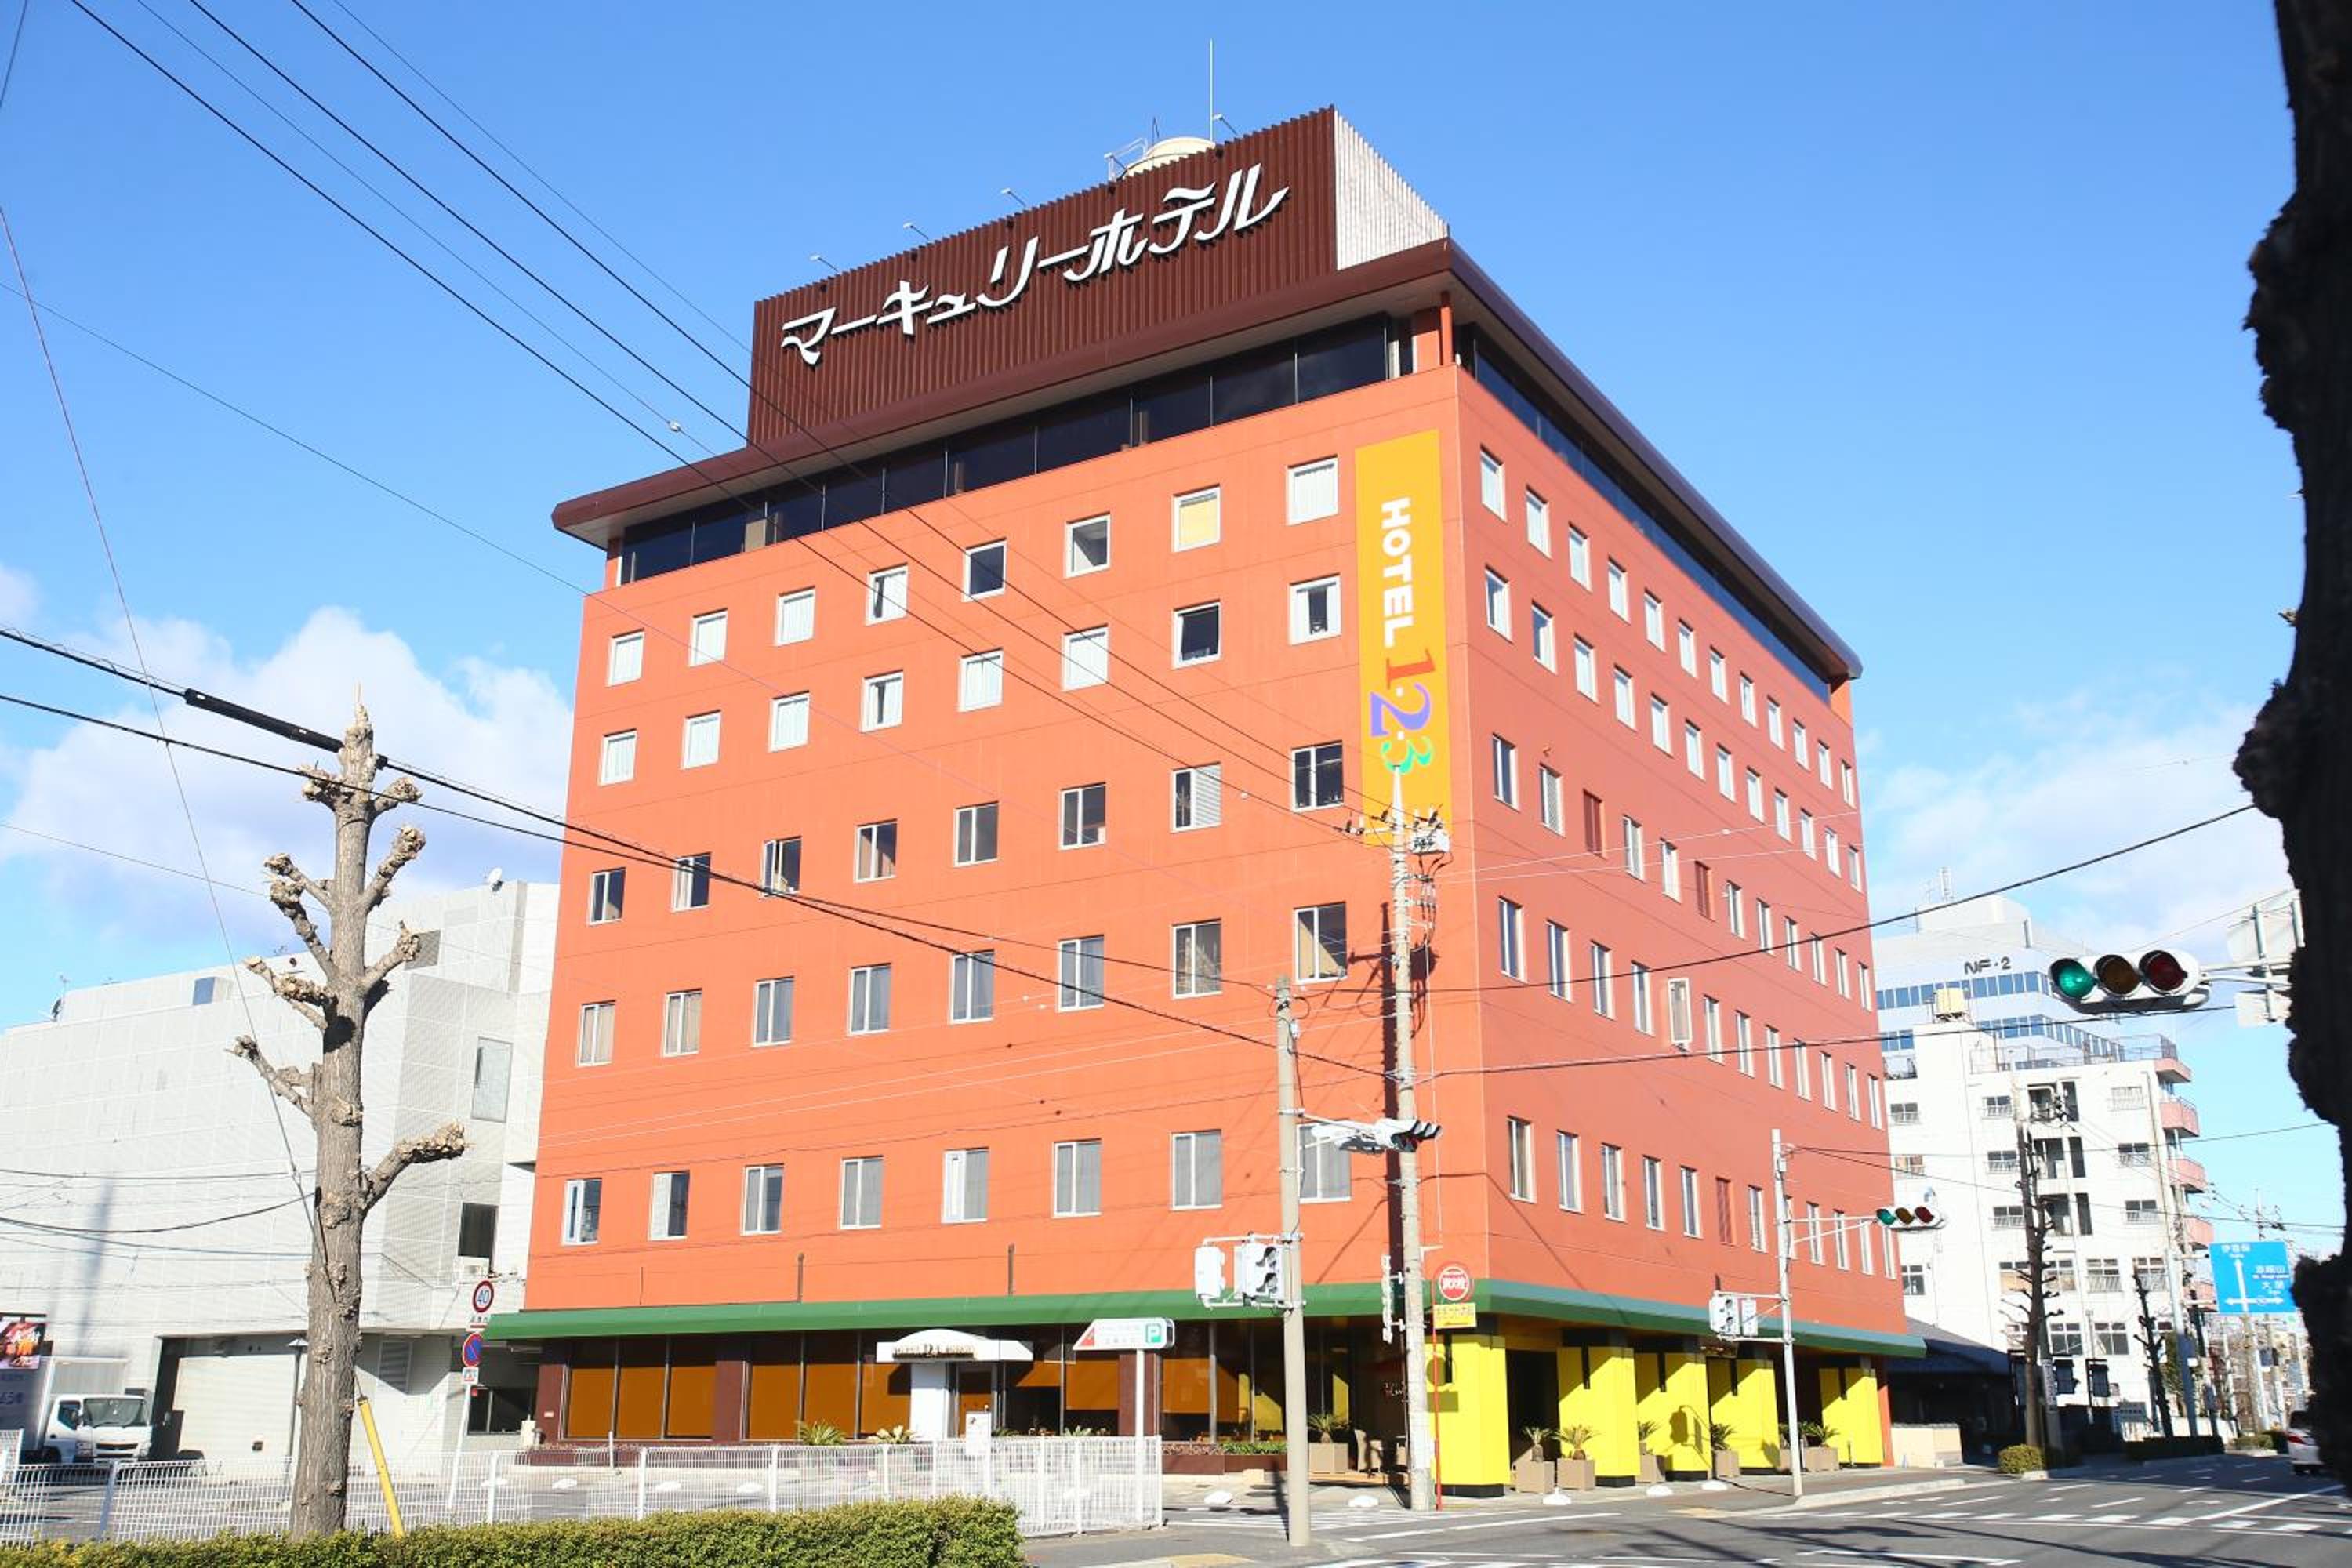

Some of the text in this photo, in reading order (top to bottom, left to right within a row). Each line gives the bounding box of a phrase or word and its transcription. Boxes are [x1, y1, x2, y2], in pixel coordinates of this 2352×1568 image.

[781, 162, 1290, 365] マーキュリーホテル
[1381, 496, 1414, 648] HOTEL
[477, 1289, 490, 1305] 40
[1147, 1325, 1161, 1344] P
